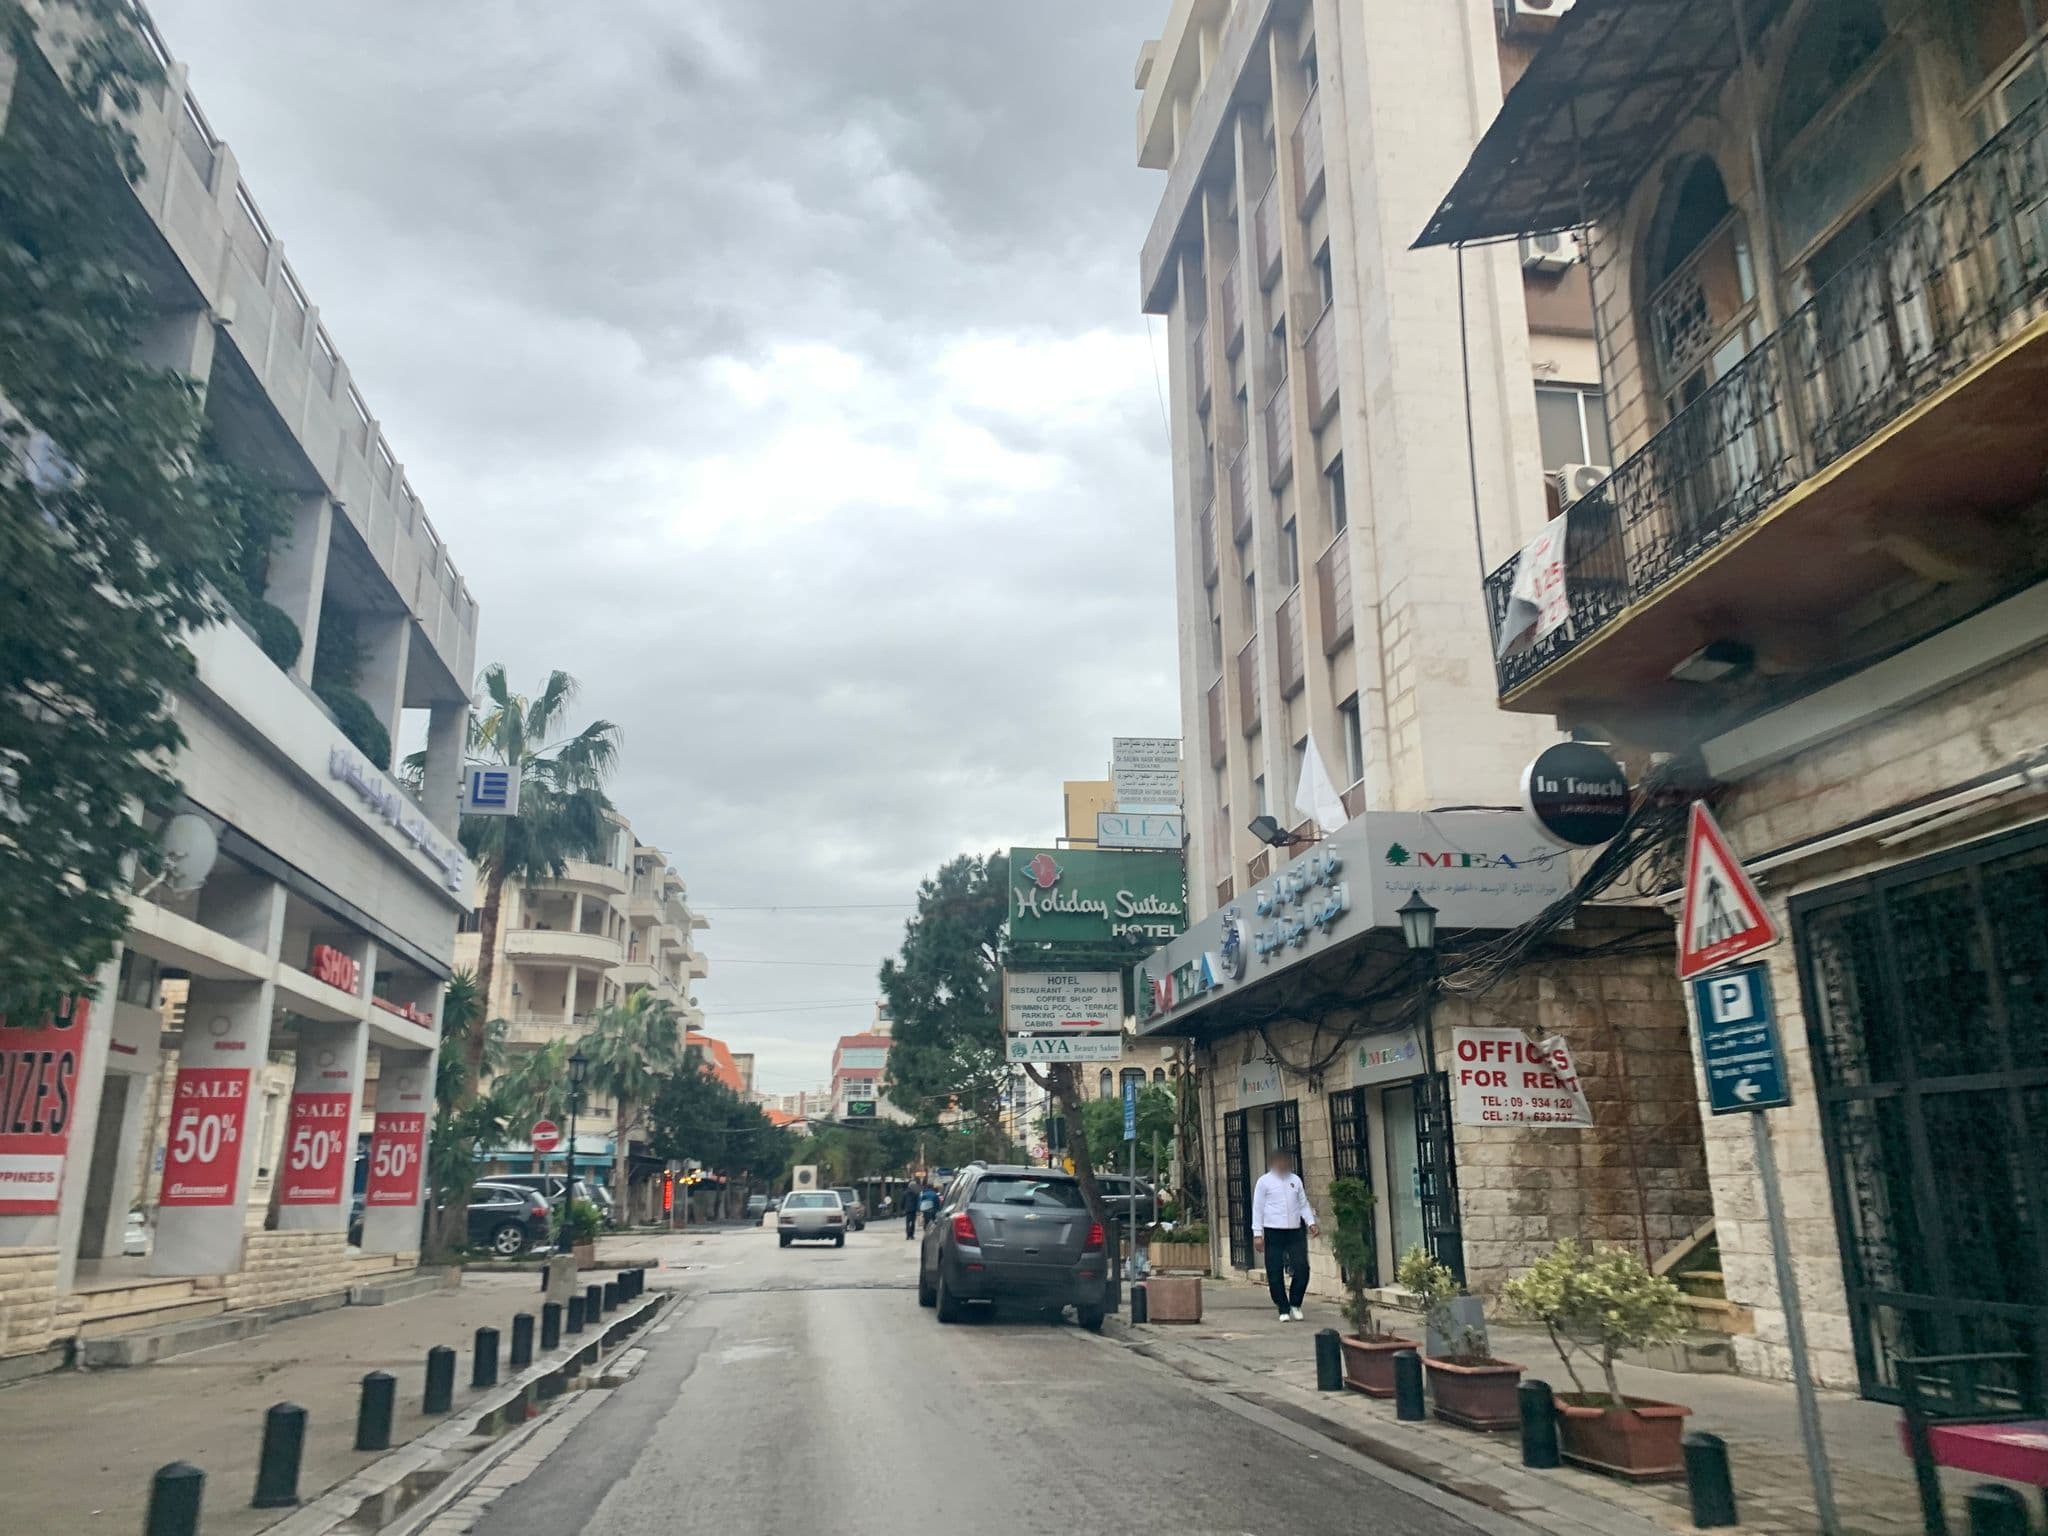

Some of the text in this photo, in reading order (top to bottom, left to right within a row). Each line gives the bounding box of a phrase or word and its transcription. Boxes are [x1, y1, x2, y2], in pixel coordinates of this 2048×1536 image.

[1537, 775, 1623, 796] In Touch
[1418, 852, 1518, 869] MEA
[1014, 887, 1182, 919] Holiday Suites
[1047, 976, 1080, 985] HOTEL
[1031, 1039, 1070, 1054] AYA
[1457, 1039, 1569, 1070] OFFICS
[1460, 1069, 1508, 1088] FOR
[180, 1080, 244, 1098] SALE
[295, 1103, 347, 1118] SALE
[1510, 1097, 1523, 1107] 09
[1531, 1097, 1550, 1108] 934
[1554, 1098, 1573, 1109] 120
[1512, 1111, 1524, 1121] 71
[377, 1120, 421, 1134] SALE
[173, 1113, 237, 1163] 50%
[291, 1129, 343, 1171] 50%
[374, 1143, 418, 1177] 50%
